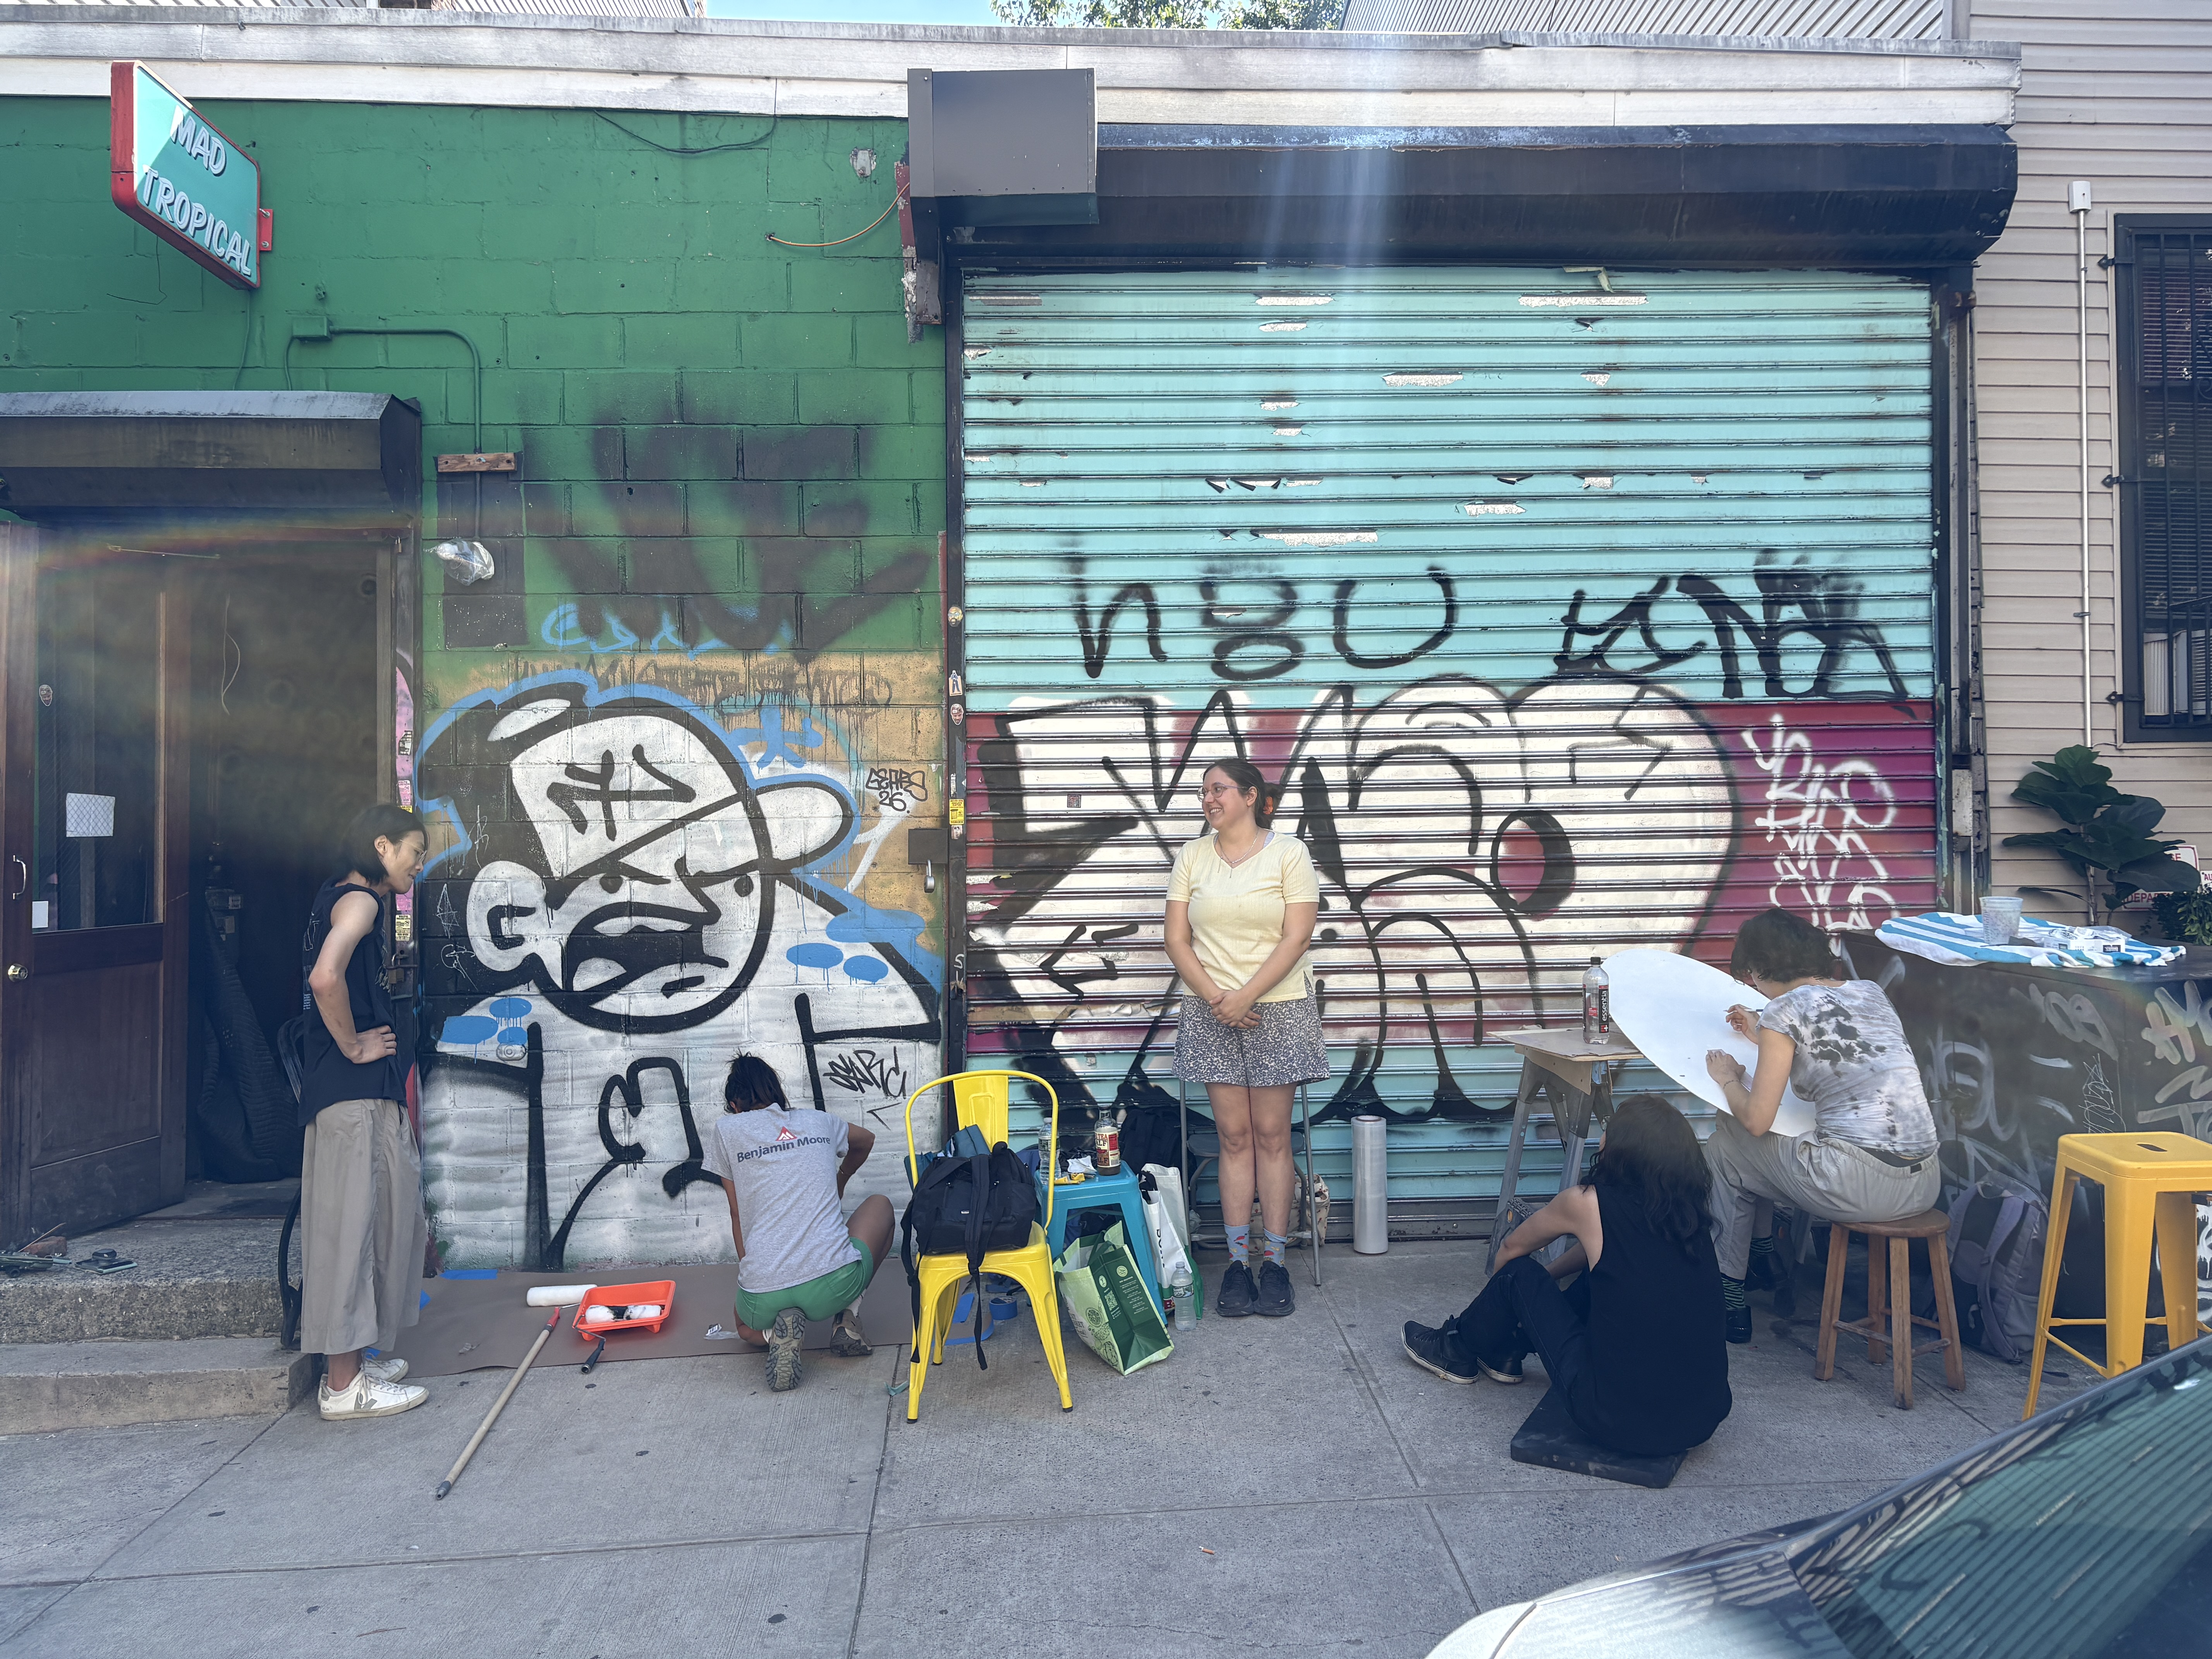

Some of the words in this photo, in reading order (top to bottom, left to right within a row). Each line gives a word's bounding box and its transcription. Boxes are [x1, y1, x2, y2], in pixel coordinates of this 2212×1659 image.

[170, 105, 226, 176] MAD
[142, 164, 252, 278] TROPICAL
[737, 1141, 795, 1163] Benjamin
[797, 1137, 831, 1147] Moore
